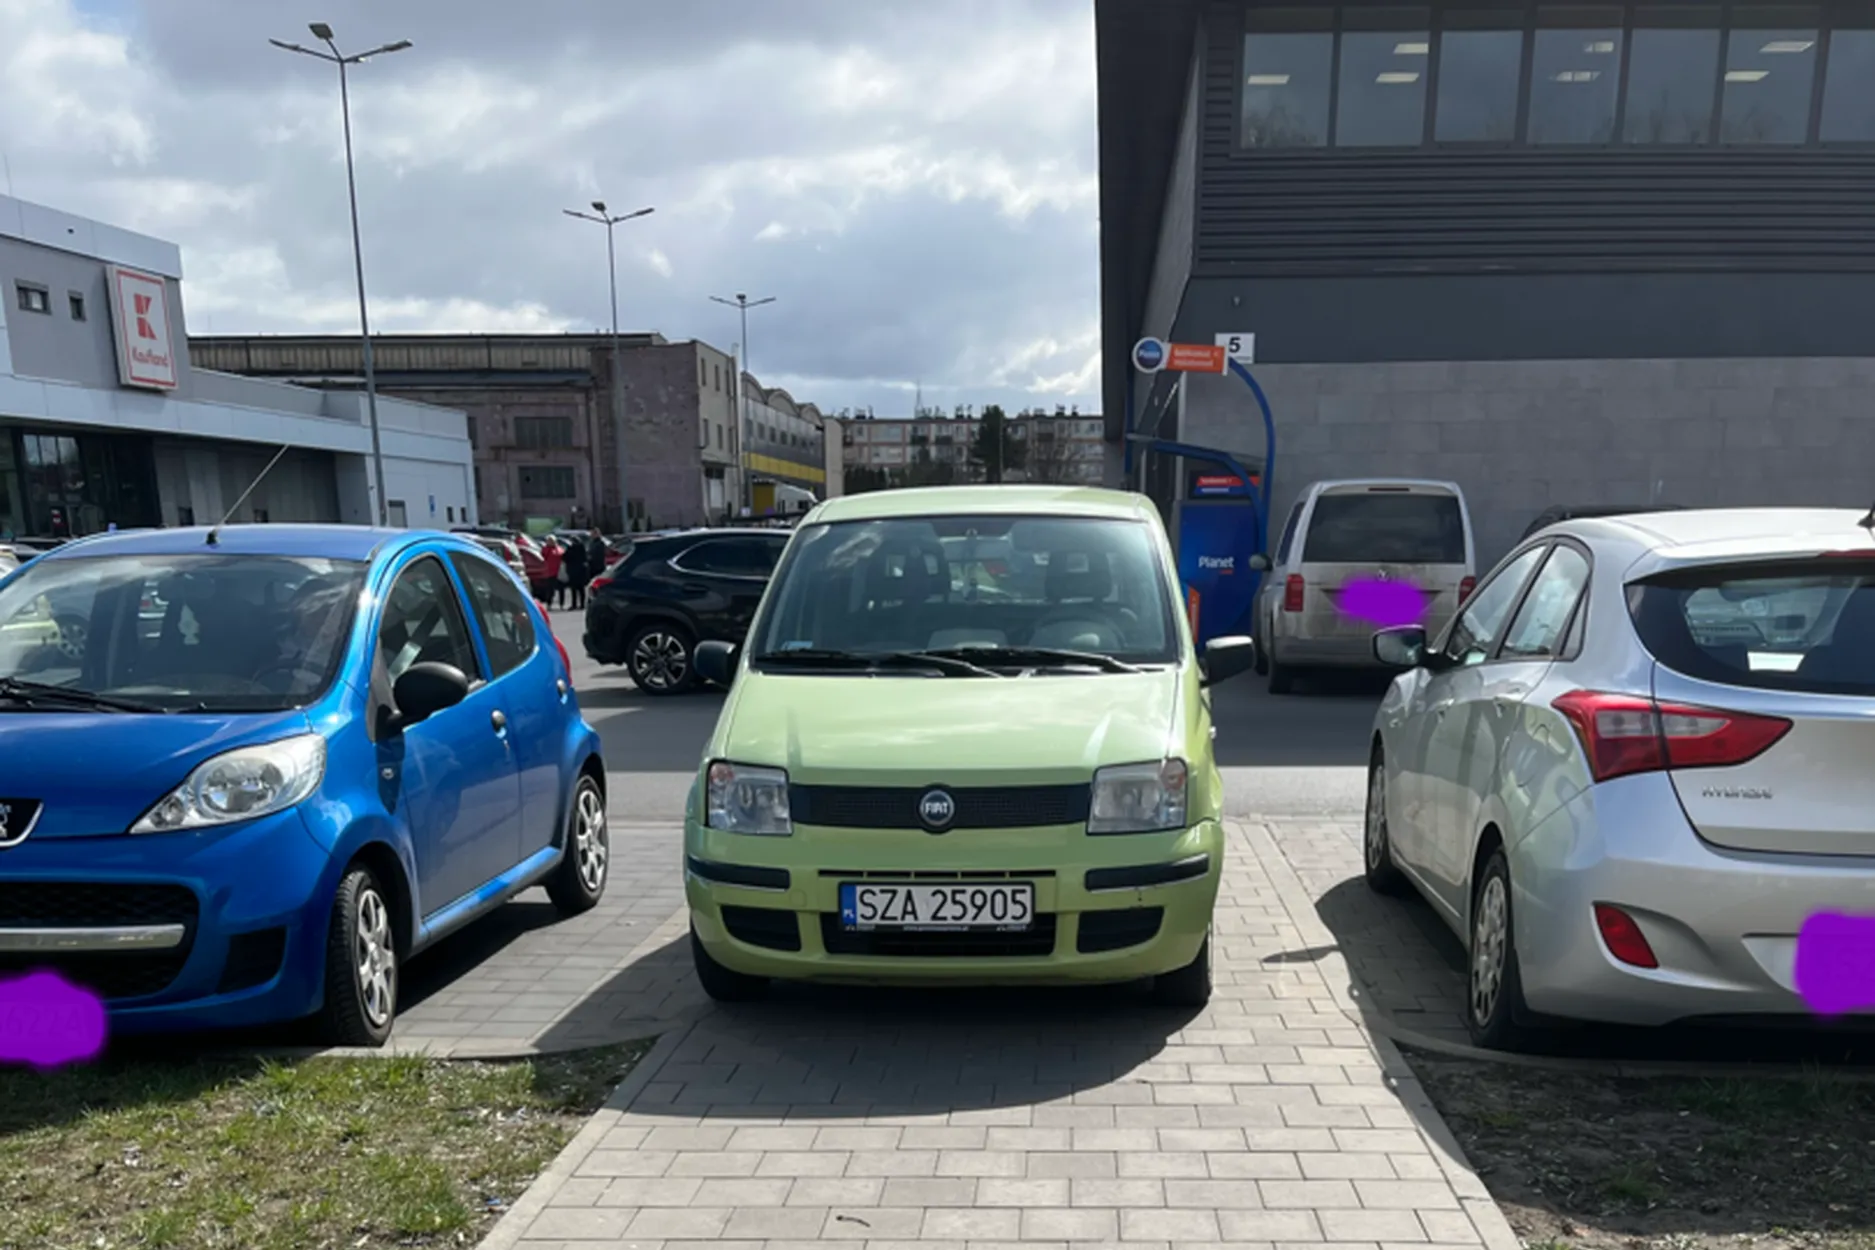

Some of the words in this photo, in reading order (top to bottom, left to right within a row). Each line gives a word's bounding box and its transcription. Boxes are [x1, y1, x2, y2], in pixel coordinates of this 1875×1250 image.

[1228, 336, 1241, 353] 5
[1198, 555, 1235, 569] Planet
[925, 802, 948, 814] FIAT
[859, 889, 919, 921] SZA
[931, 889, 1028, 921] 25905
